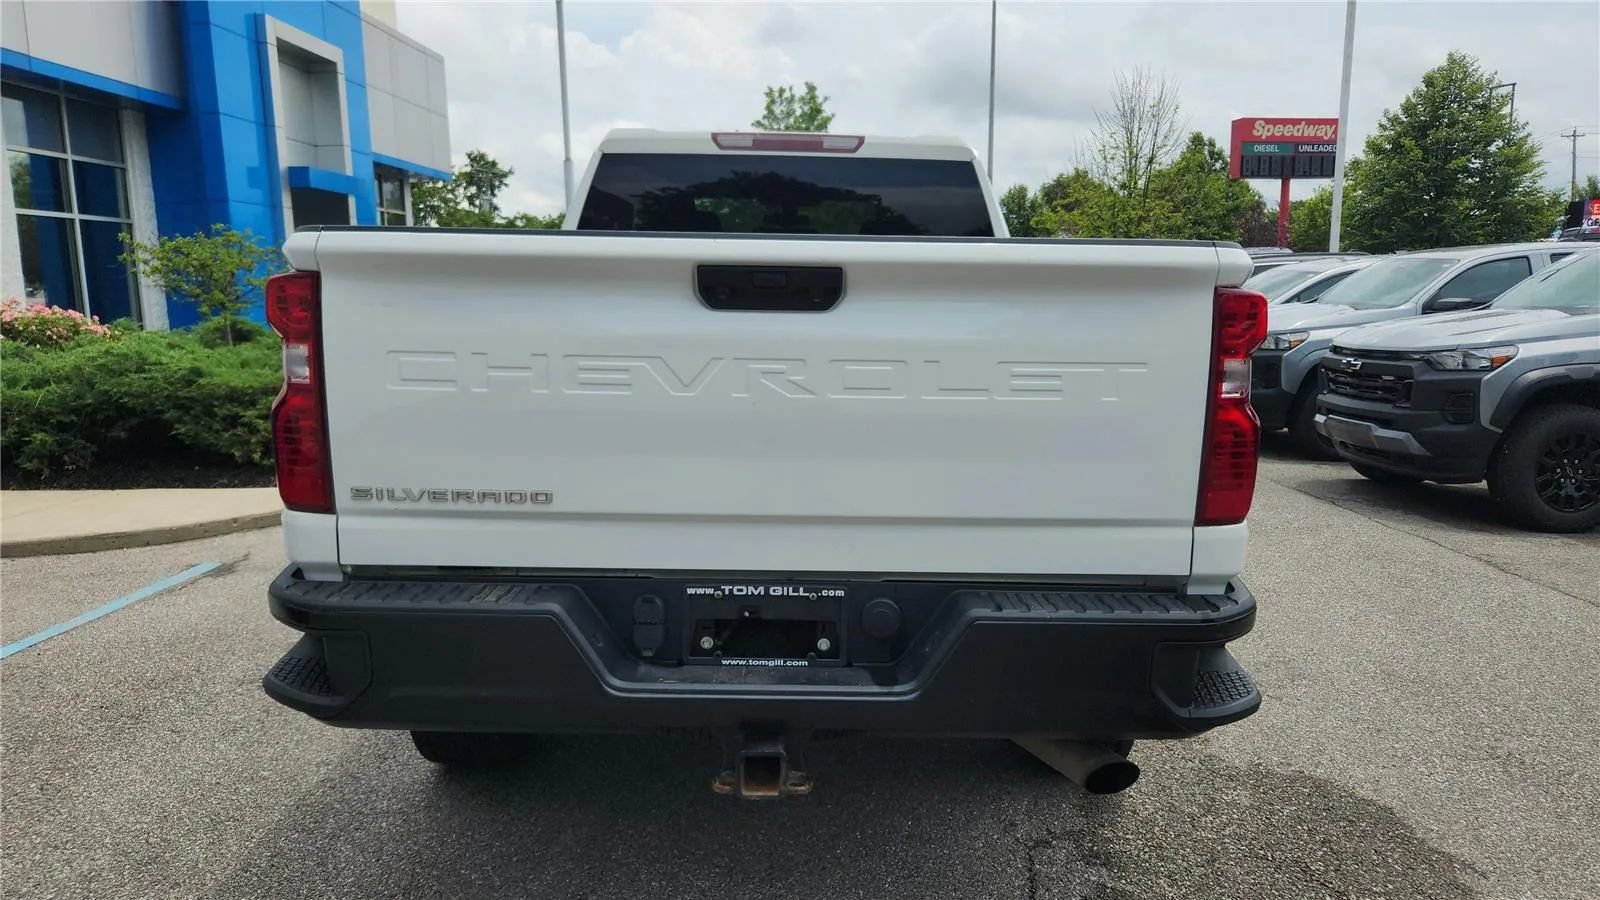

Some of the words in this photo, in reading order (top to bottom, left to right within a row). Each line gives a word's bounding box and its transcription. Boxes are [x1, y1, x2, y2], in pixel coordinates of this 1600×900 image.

[1254, 144, 1280, 152] DIESEL
[386, 350, 1149, 399] CHEVROLET
[350, 486, 554, 505] SILVERADO
[721, 585, 764, 596] TOM
[769, 586, 809, 596] GILL
[817, 588, 845, 597] .com
[721, 659, 808, 667] www.tomgill.com
